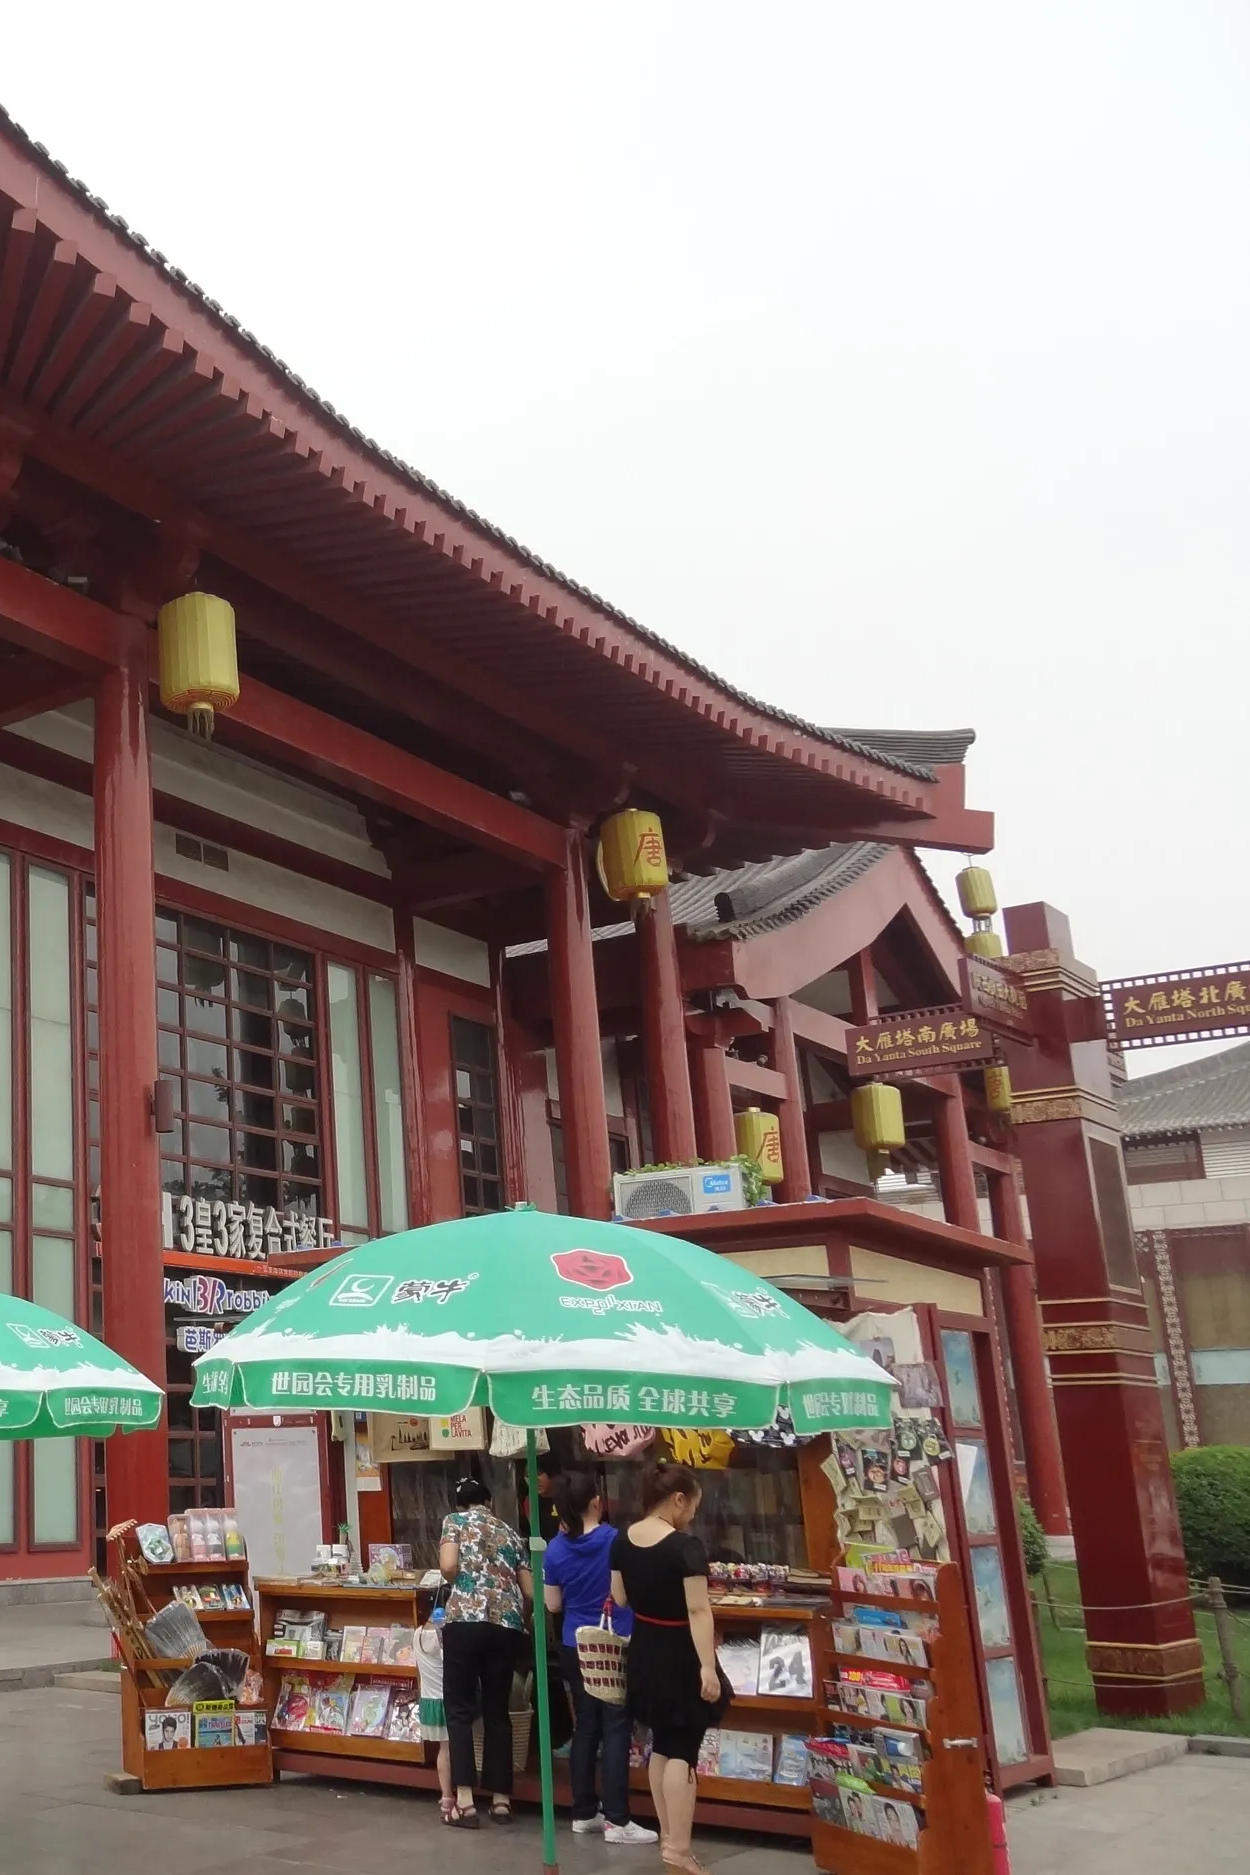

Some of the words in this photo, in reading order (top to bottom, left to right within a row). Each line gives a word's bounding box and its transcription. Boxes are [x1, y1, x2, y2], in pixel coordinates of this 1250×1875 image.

[634, 827, 662, 868] 唐
[1123, 980, 1250, 1016] 大雁塔北廣
[1125, 1016, 1144, 1028] Da
[1146, 1011, 1185, 1025] Yanta
[1187, 1006, 1226, 1020] North
[855, 1017, 980, 1054] 大雁塔南廣場
[857, 1054, 872, 1065] Da
[876, 1050, 907, 1062] Yanta
[908, 1044, 940, 1058] South
[941, 1039, 983, 1054] Square
[271, 1371, 438, 1402] 世园会专用乳制品
[531, 1383, 631, 1412] 生态品质
[637, 1386, 738, 1419] 全球共享
